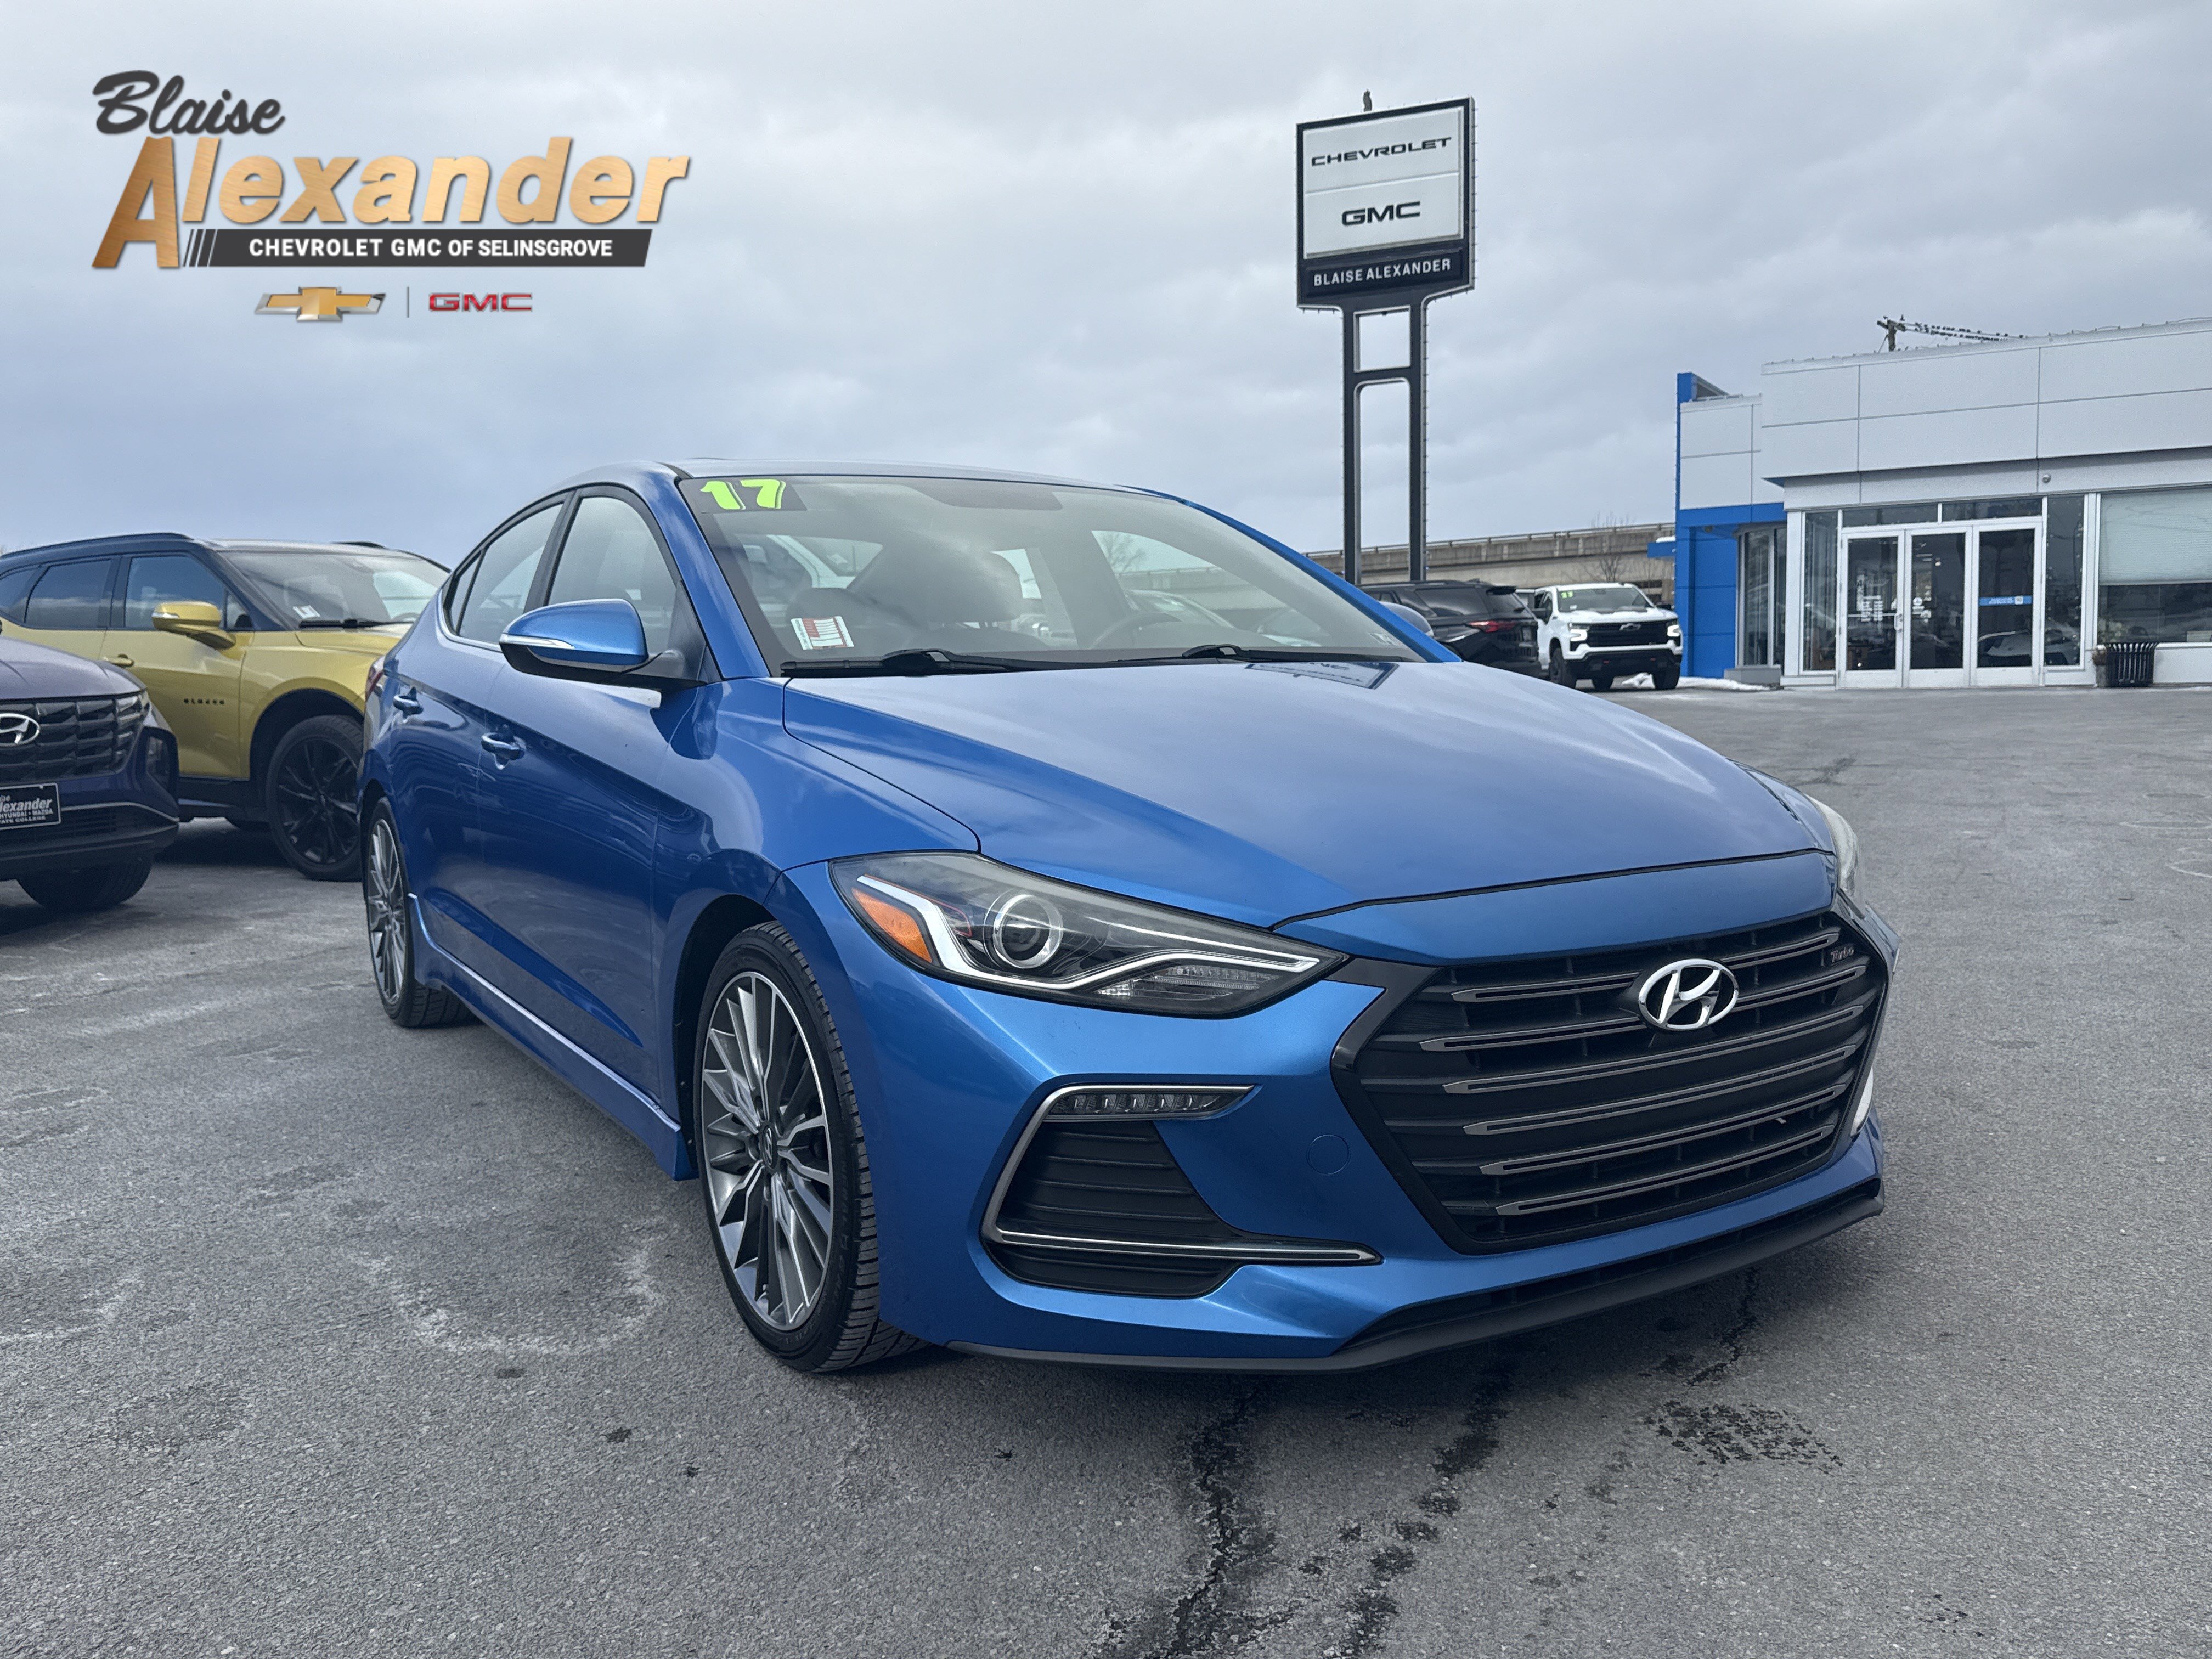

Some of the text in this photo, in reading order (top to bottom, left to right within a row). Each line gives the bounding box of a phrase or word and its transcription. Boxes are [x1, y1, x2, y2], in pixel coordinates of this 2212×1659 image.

[1311, 137, 1452, 167] CHEVROLET
[1341, 201, 1420, 226] GMC
[1313, 258, 1451, 286] BLAISE ALEXANDER
[700, 479, 786, 510] 17
[0, 797, 52, 812] lexander
[1831, 947, 1854, 963] Turbo
